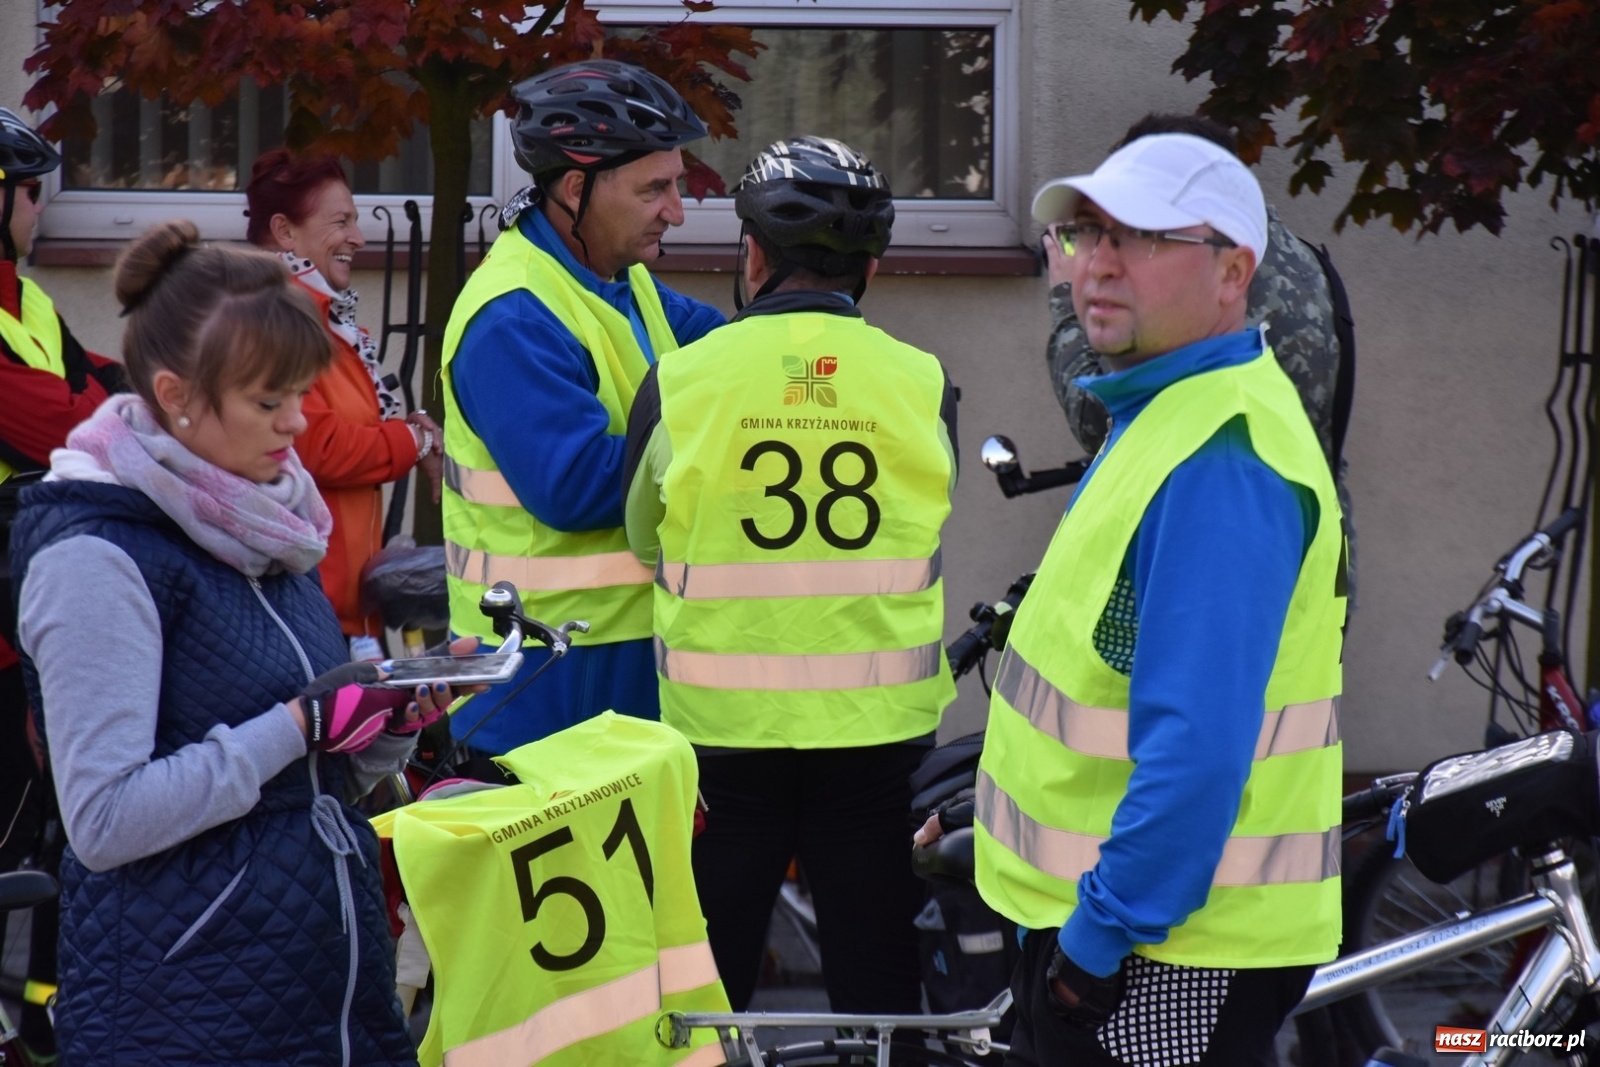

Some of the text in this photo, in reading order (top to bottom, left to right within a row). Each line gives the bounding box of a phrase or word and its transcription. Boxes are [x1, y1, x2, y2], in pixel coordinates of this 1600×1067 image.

[741, 417, 878, 433] GMINA KRZYŻANOWICE
[740, 440, 881, 550] 38
[491, 773, 643, 844] GMINA KRZYŻANOWICE
[510, 797, 654, 972] 51
